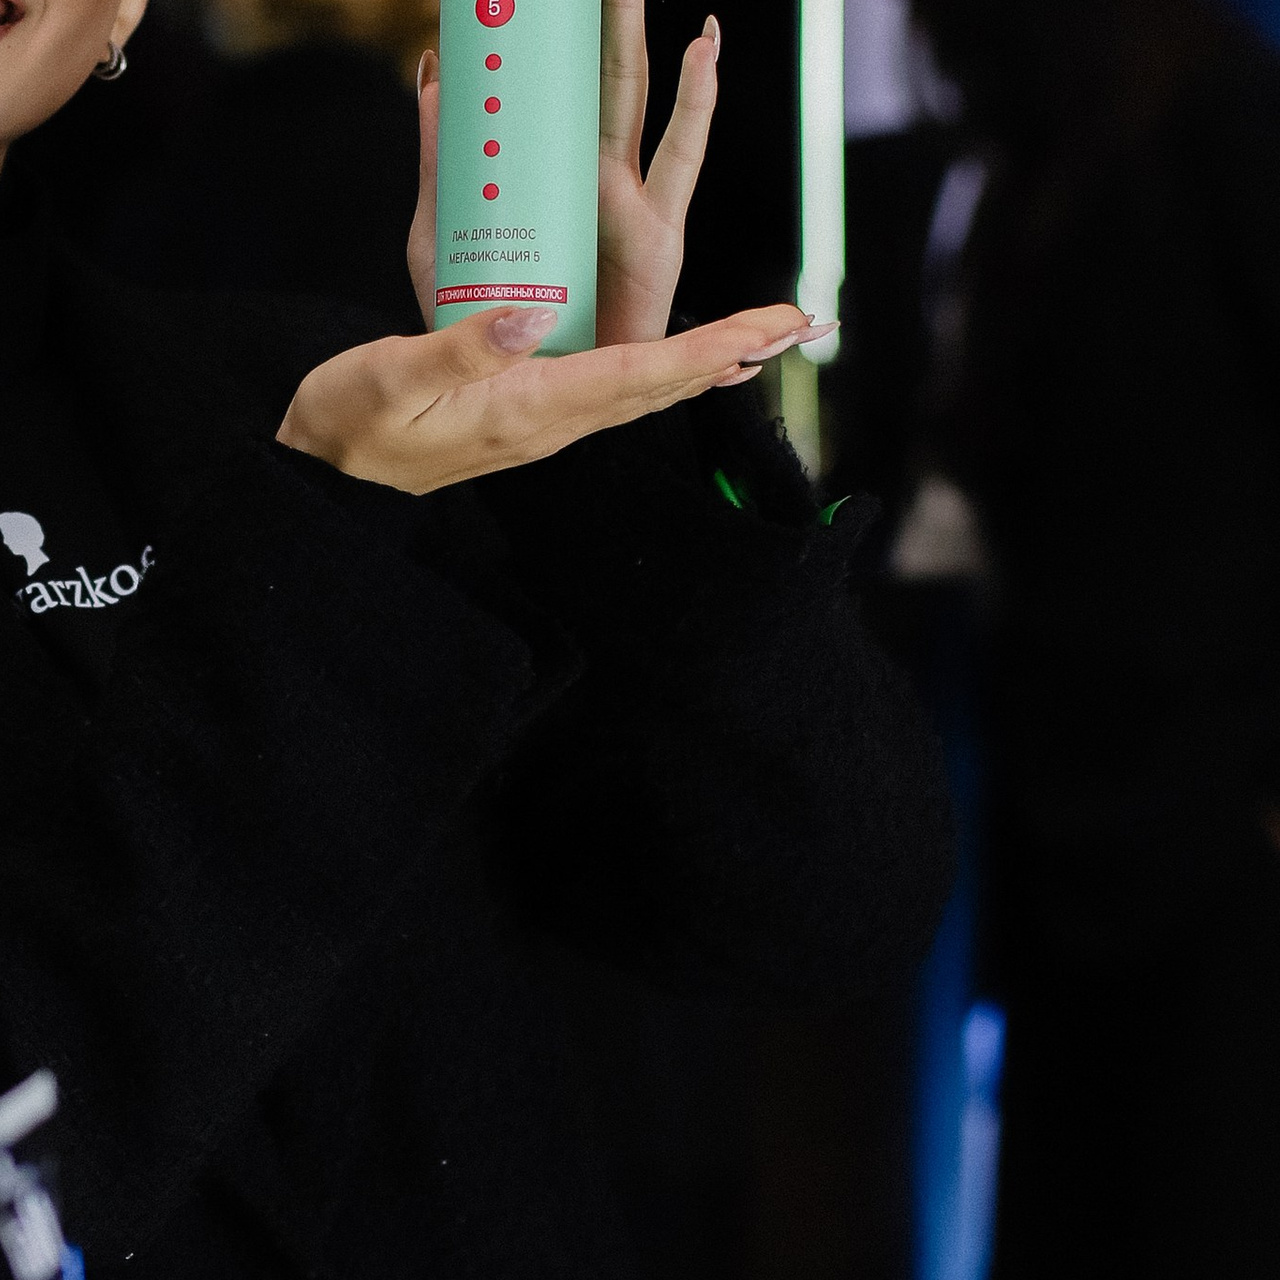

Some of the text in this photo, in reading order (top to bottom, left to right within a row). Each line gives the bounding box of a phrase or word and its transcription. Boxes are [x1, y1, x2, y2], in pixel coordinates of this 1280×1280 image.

[451, 227, 537, 242] ЛАК ДЛЯ ВОЛОС
[448, 250, 541, 265] МЕГАФИКСАЦИЯ 5
[467, 288, 473, 299] И
[473, 287, 535, 299] ОСЛАБЛЕННЫХ
[535, 288, 564, 300] ВОЛОС
[16, 545, 156, 614] arzko
